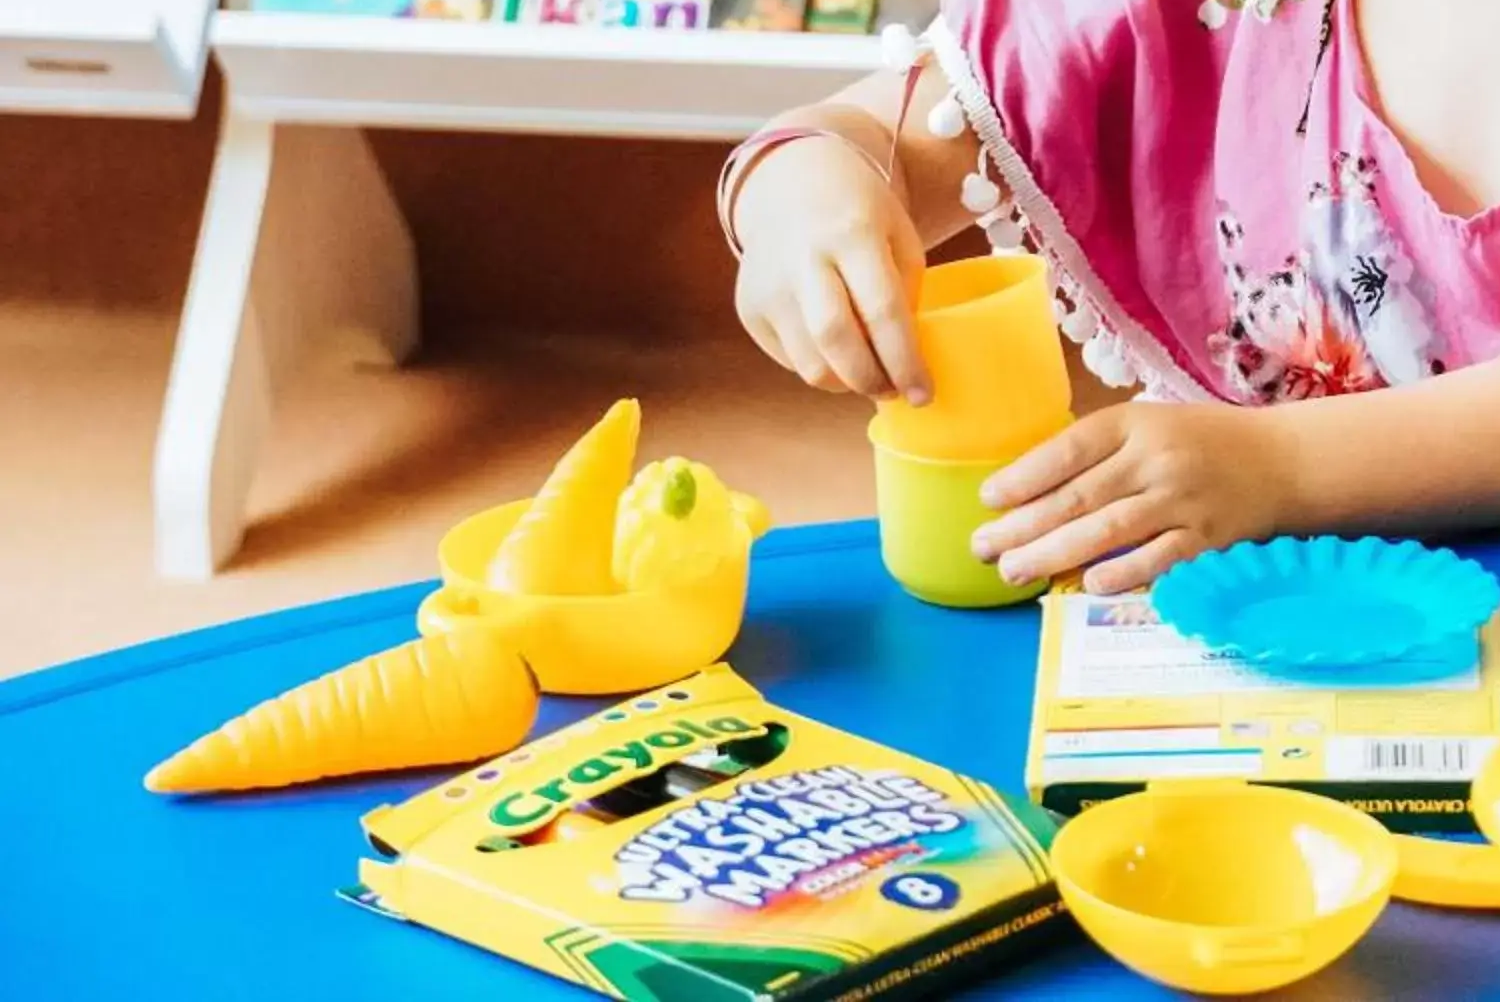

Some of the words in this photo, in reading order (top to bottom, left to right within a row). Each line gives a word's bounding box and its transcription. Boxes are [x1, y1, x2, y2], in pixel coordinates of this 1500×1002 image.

[488, 716, 760, 827] Crayola
[619, 775, 949, 902] WASHABLE
[702, 803, 967, 906] MARKERS
[895, 876, 944, 905] 8
